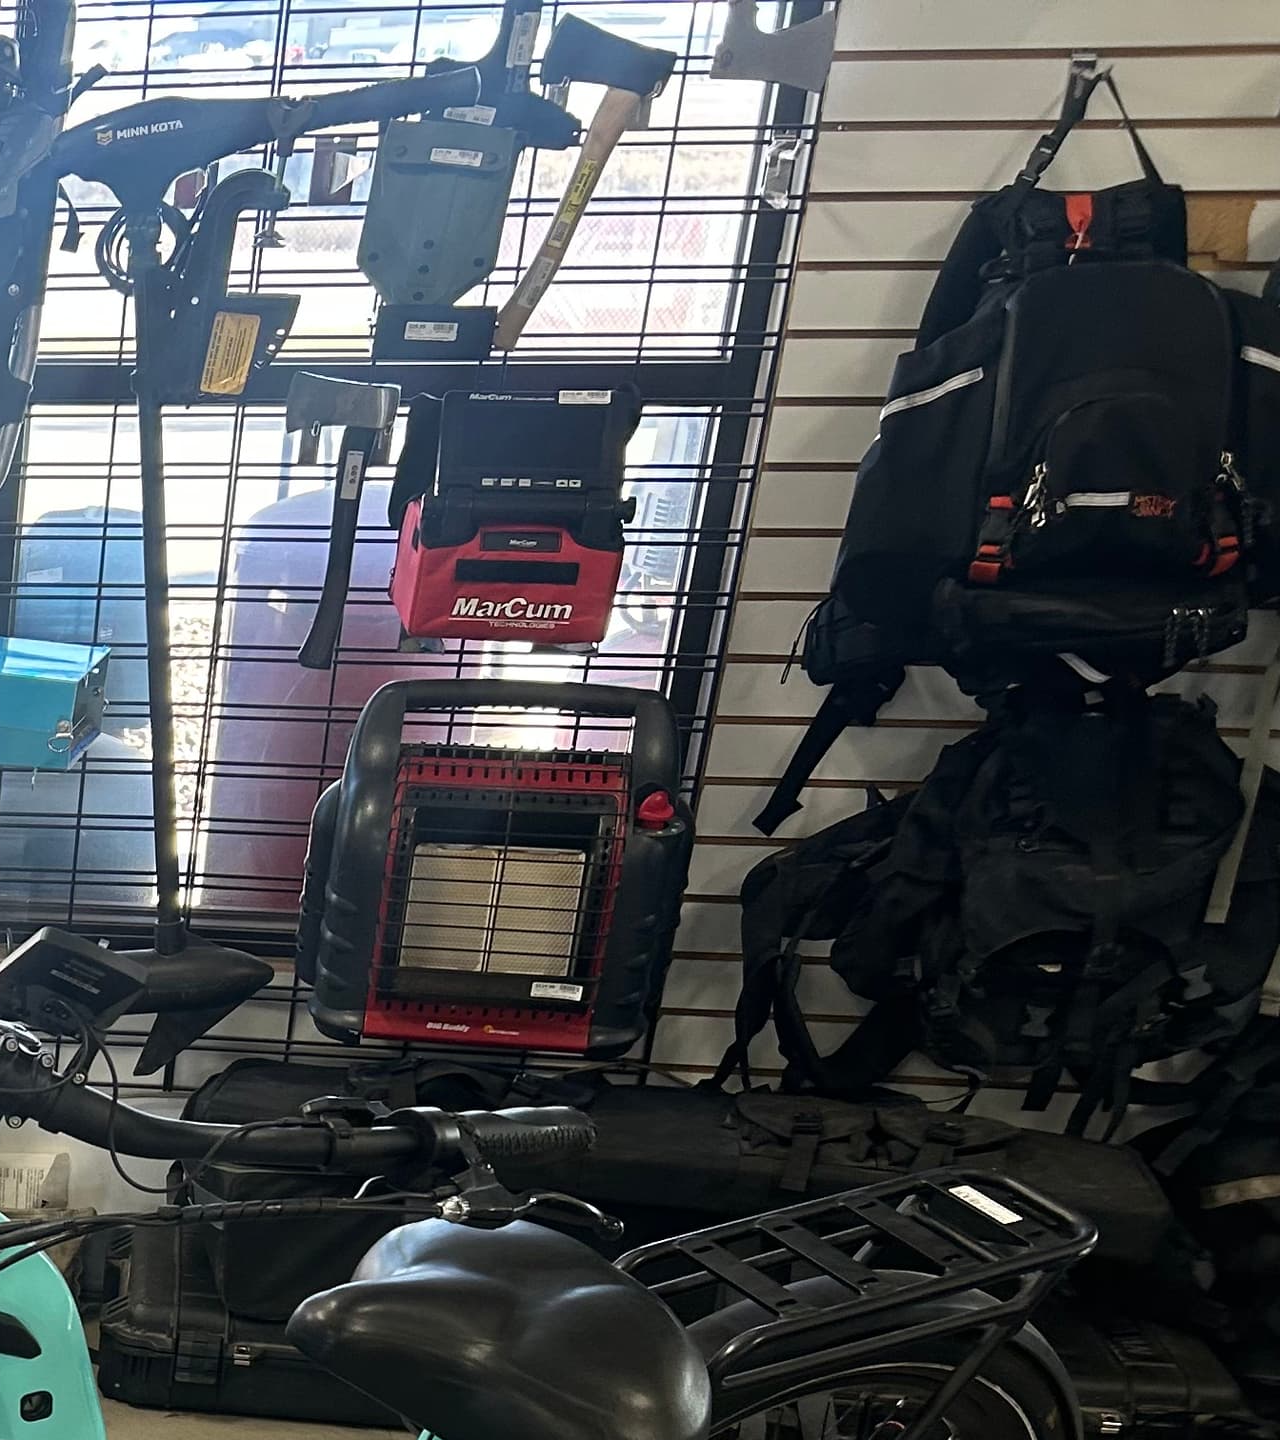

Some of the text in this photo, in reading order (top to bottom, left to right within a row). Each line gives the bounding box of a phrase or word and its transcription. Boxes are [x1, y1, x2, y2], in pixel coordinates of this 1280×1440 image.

[116, 119, 184, 140] MINN KOTA
[451, 597, 573, 619] MarCum
